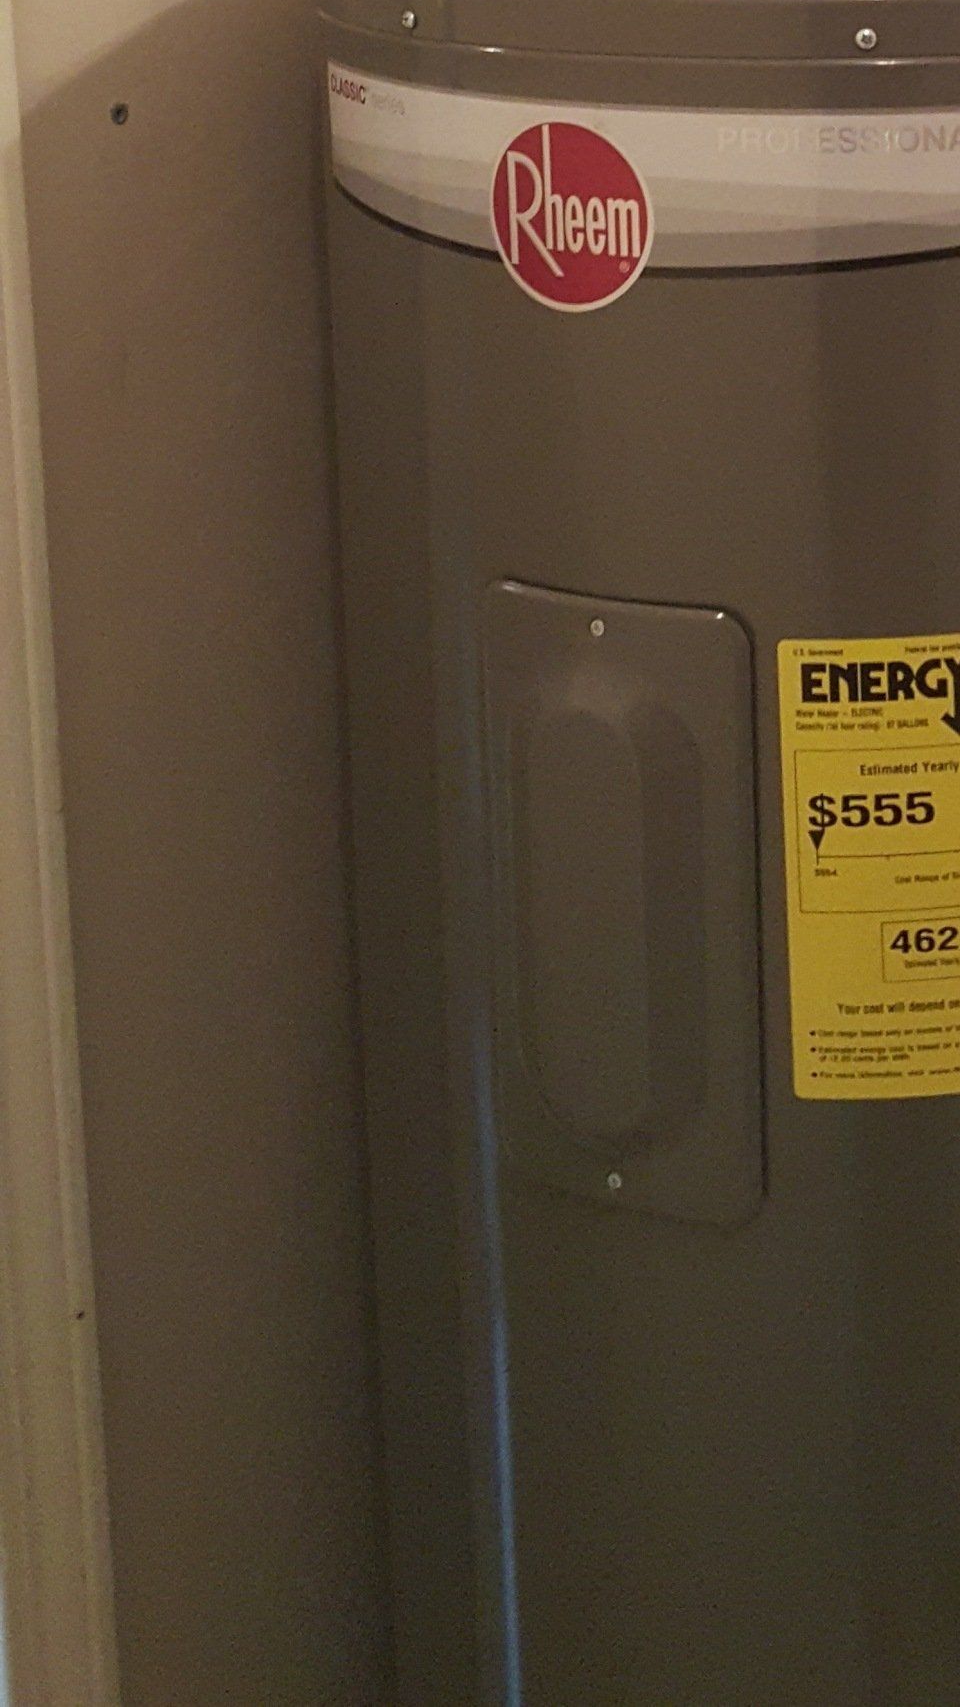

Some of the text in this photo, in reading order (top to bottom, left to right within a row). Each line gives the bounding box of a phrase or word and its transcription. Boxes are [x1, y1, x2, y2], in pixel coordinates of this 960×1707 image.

[331, 73, 366, 104] CLASSIC
[506, 123, 641, 277] Rheem
[860, 762, 918, 777] Estimated
[921, 759, 960, 775] Yearly
[808, 791, 935, 829] $555
